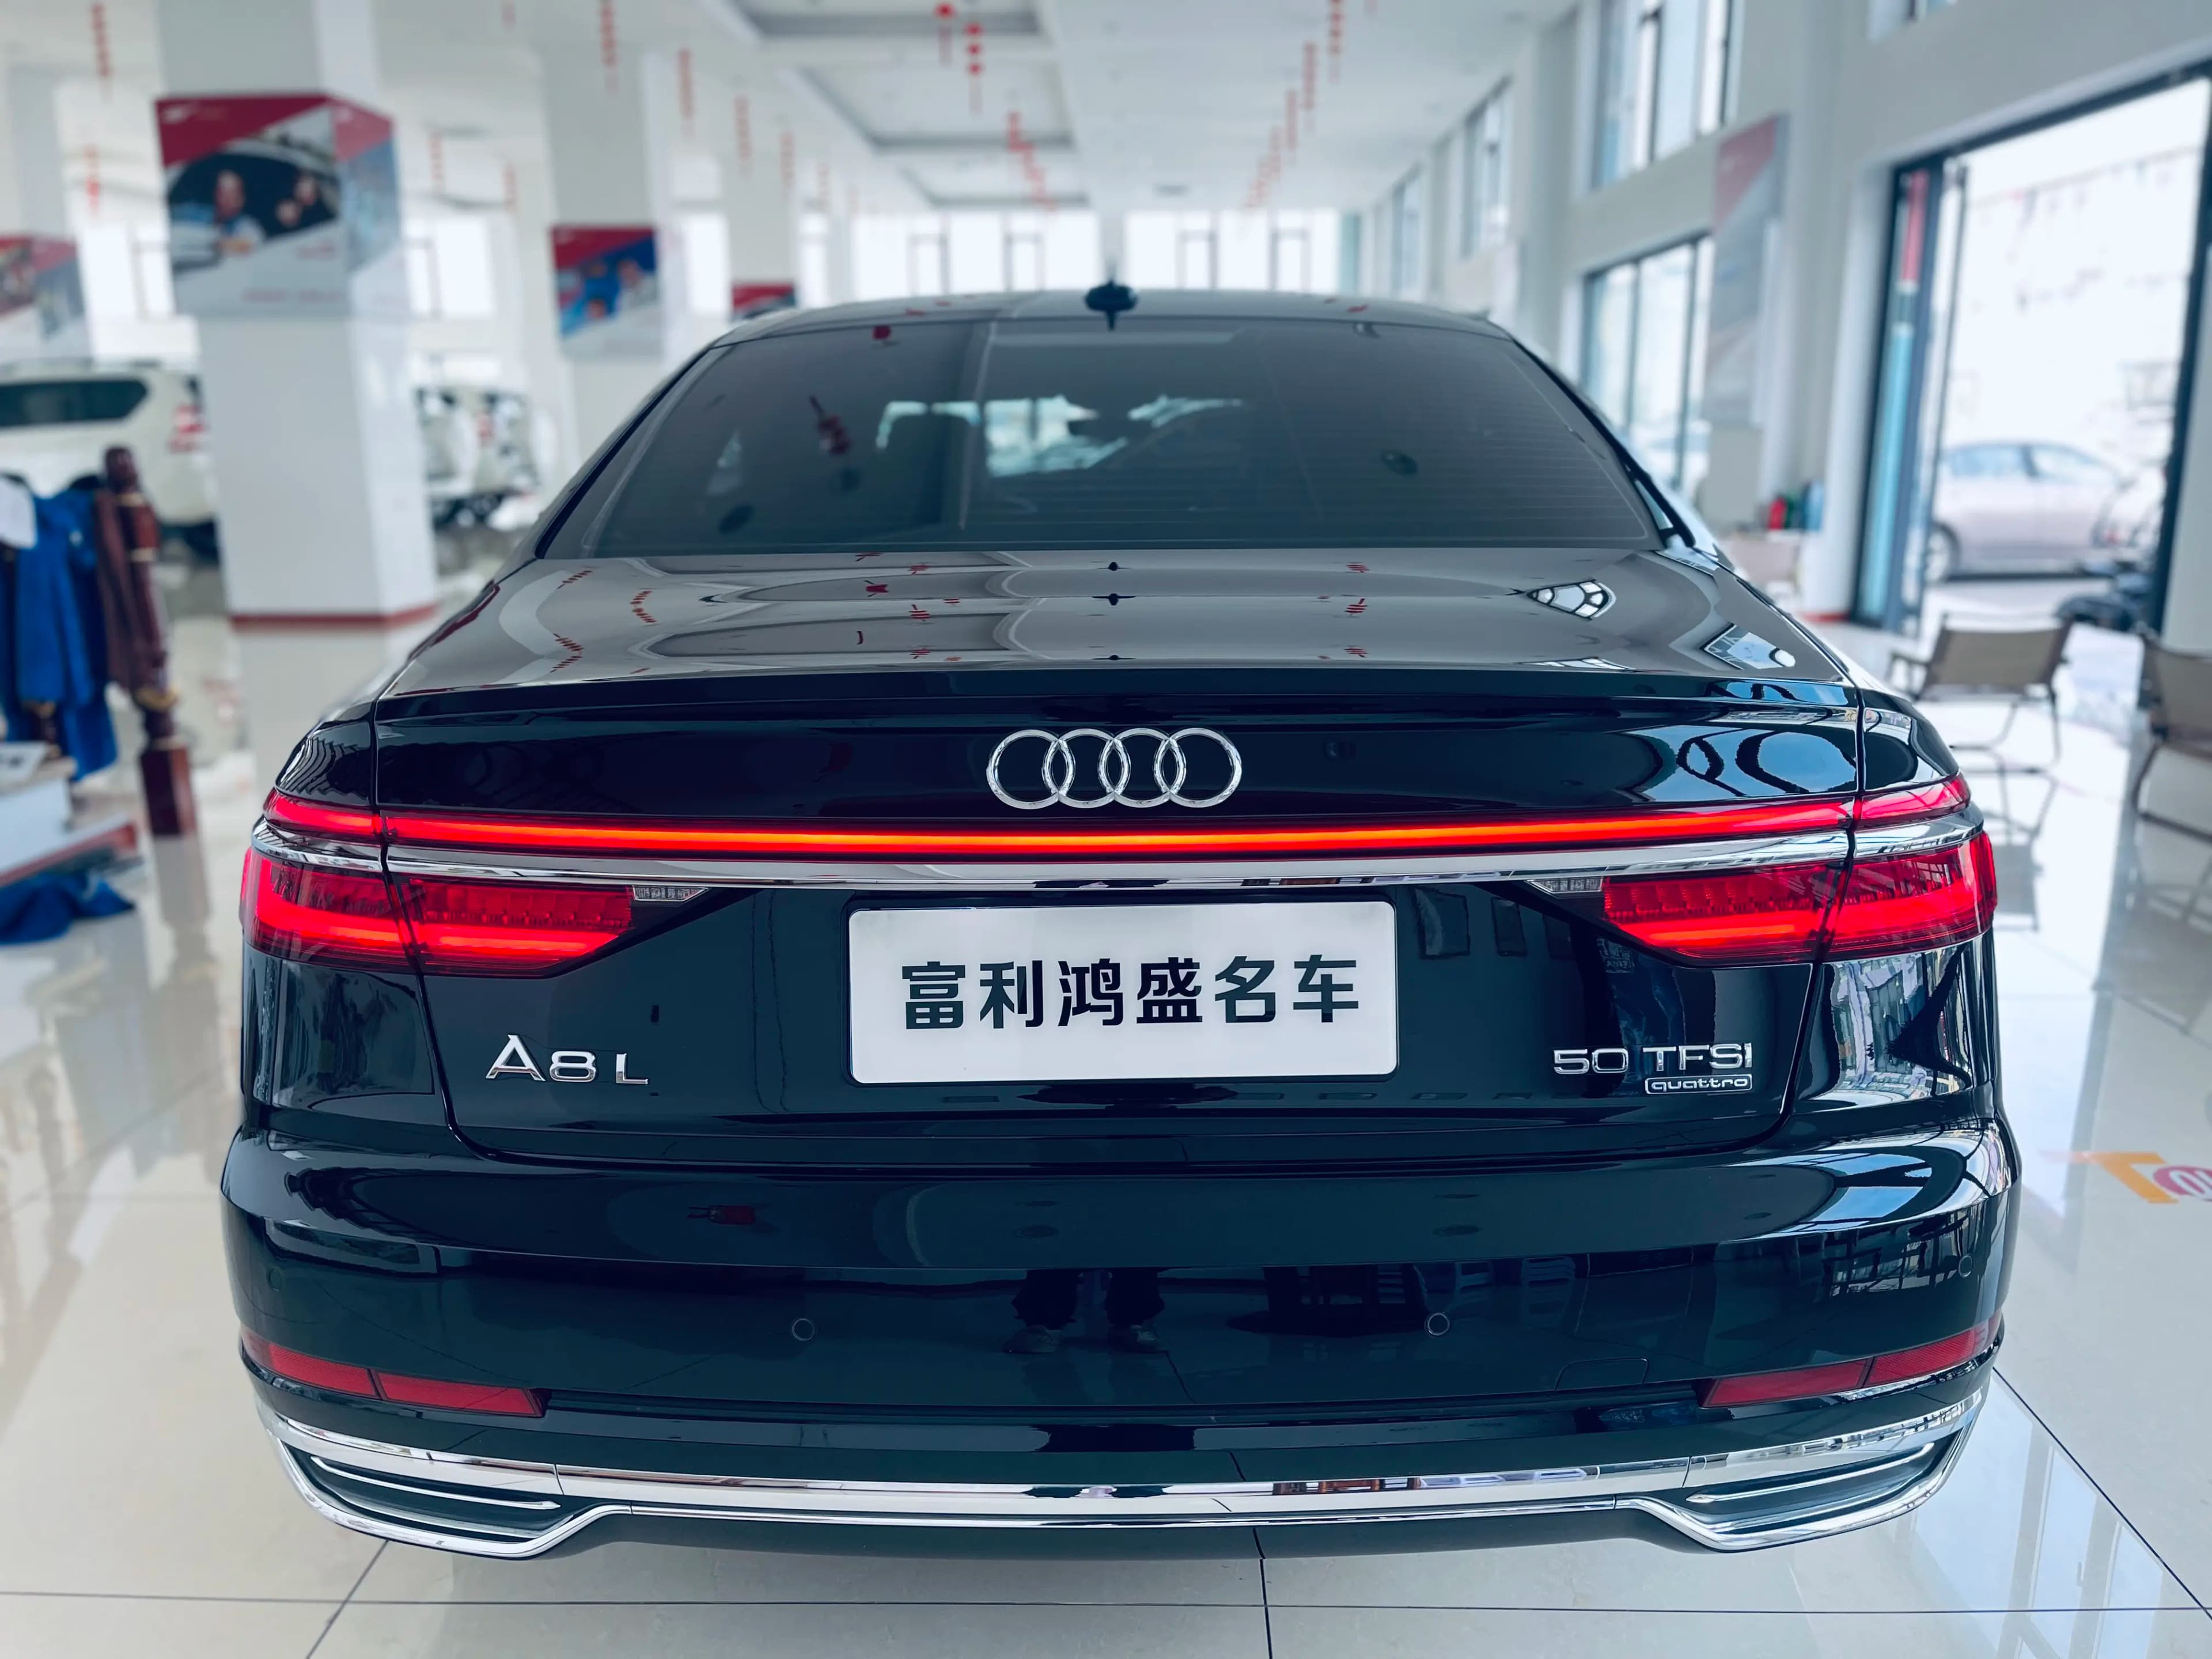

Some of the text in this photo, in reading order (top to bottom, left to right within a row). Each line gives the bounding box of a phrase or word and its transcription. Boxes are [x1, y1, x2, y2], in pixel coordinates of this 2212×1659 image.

[902, 955, 1358, 1029] 富利鸿盛名车
[486, 1034, 649, 1084] A8 L
[1554, 1043, 1752, 1074] 50 TFSI
[1651, 1078, 1749, 1092] quattro
